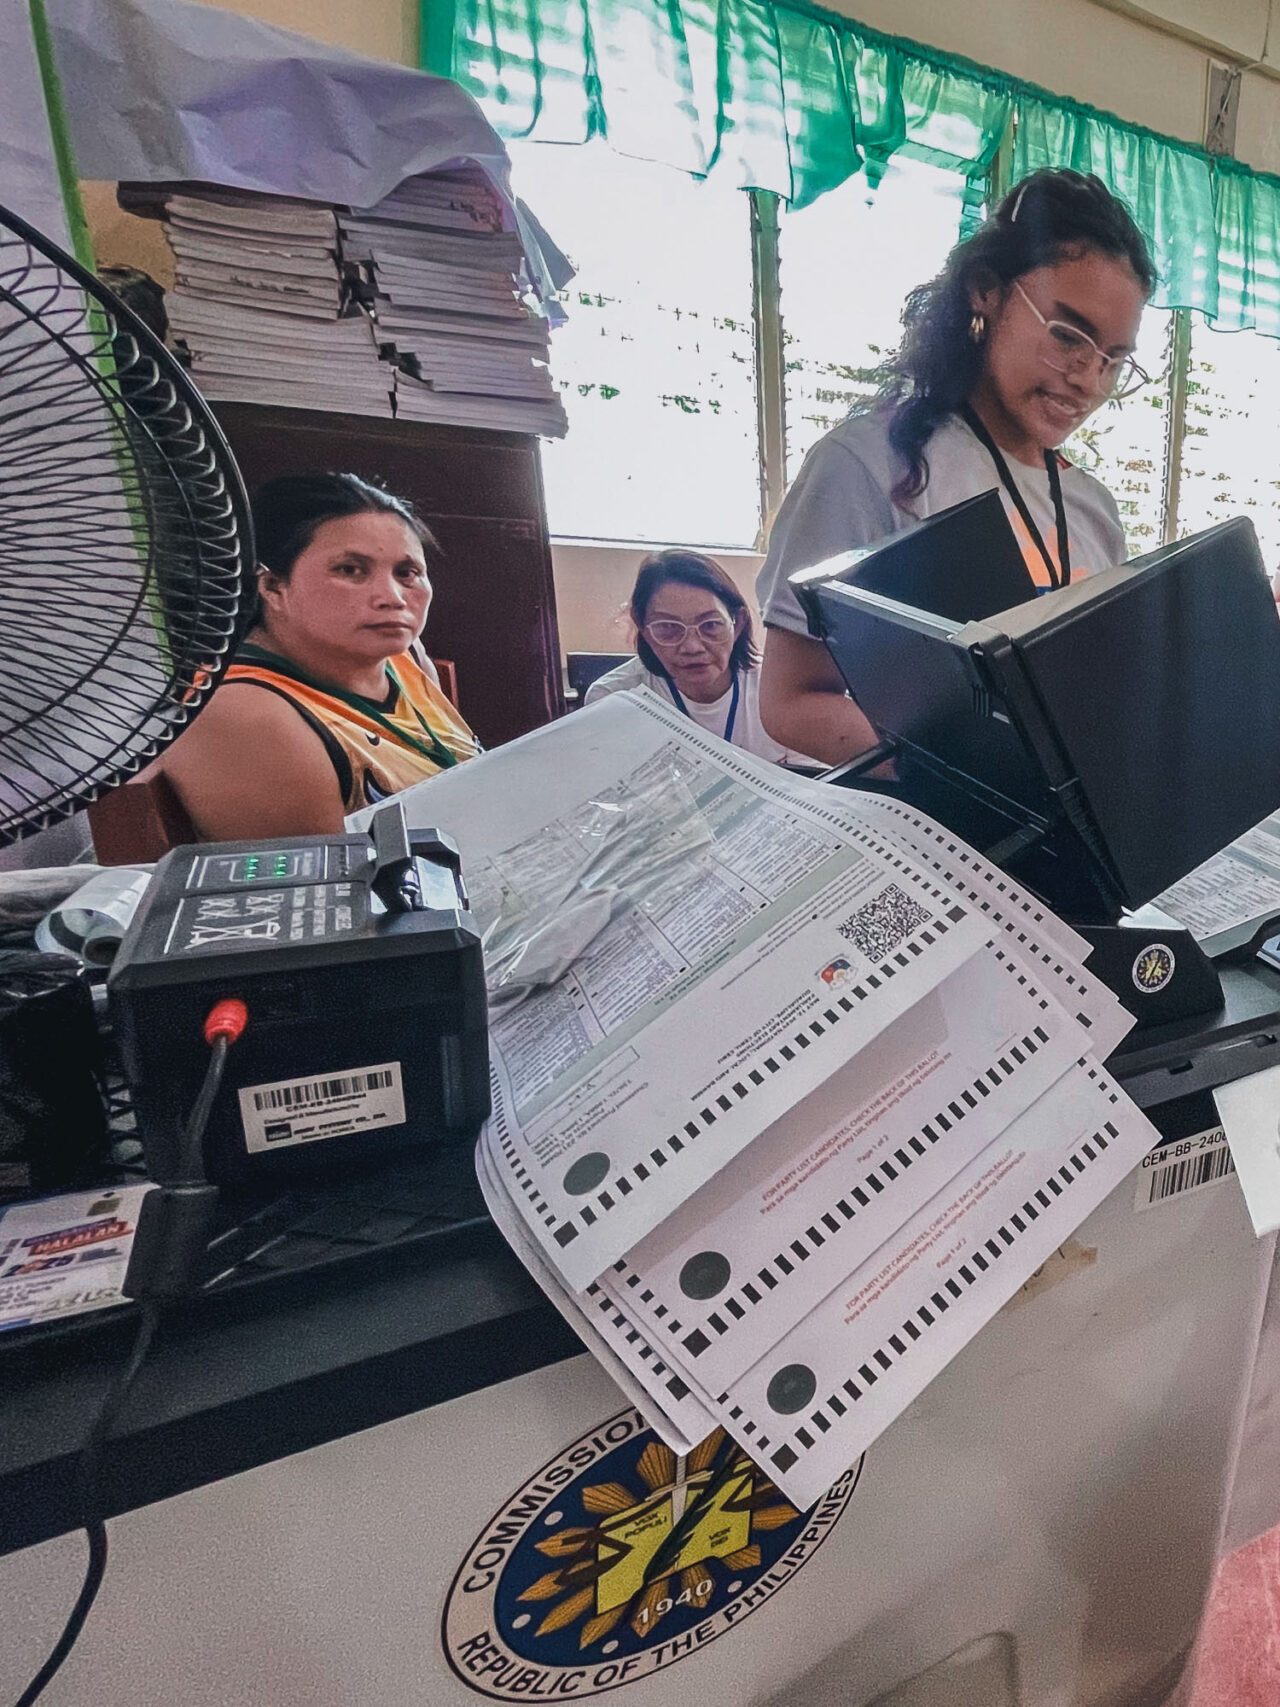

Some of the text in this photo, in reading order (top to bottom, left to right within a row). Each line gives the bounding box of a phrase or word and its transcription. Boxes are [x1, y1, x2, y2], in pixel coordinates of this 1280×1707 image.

[458, 1468, 854, 1696] REPUBLIC OF THE PHILIPPINES
[637, 1579, 713, 1625] 1940
